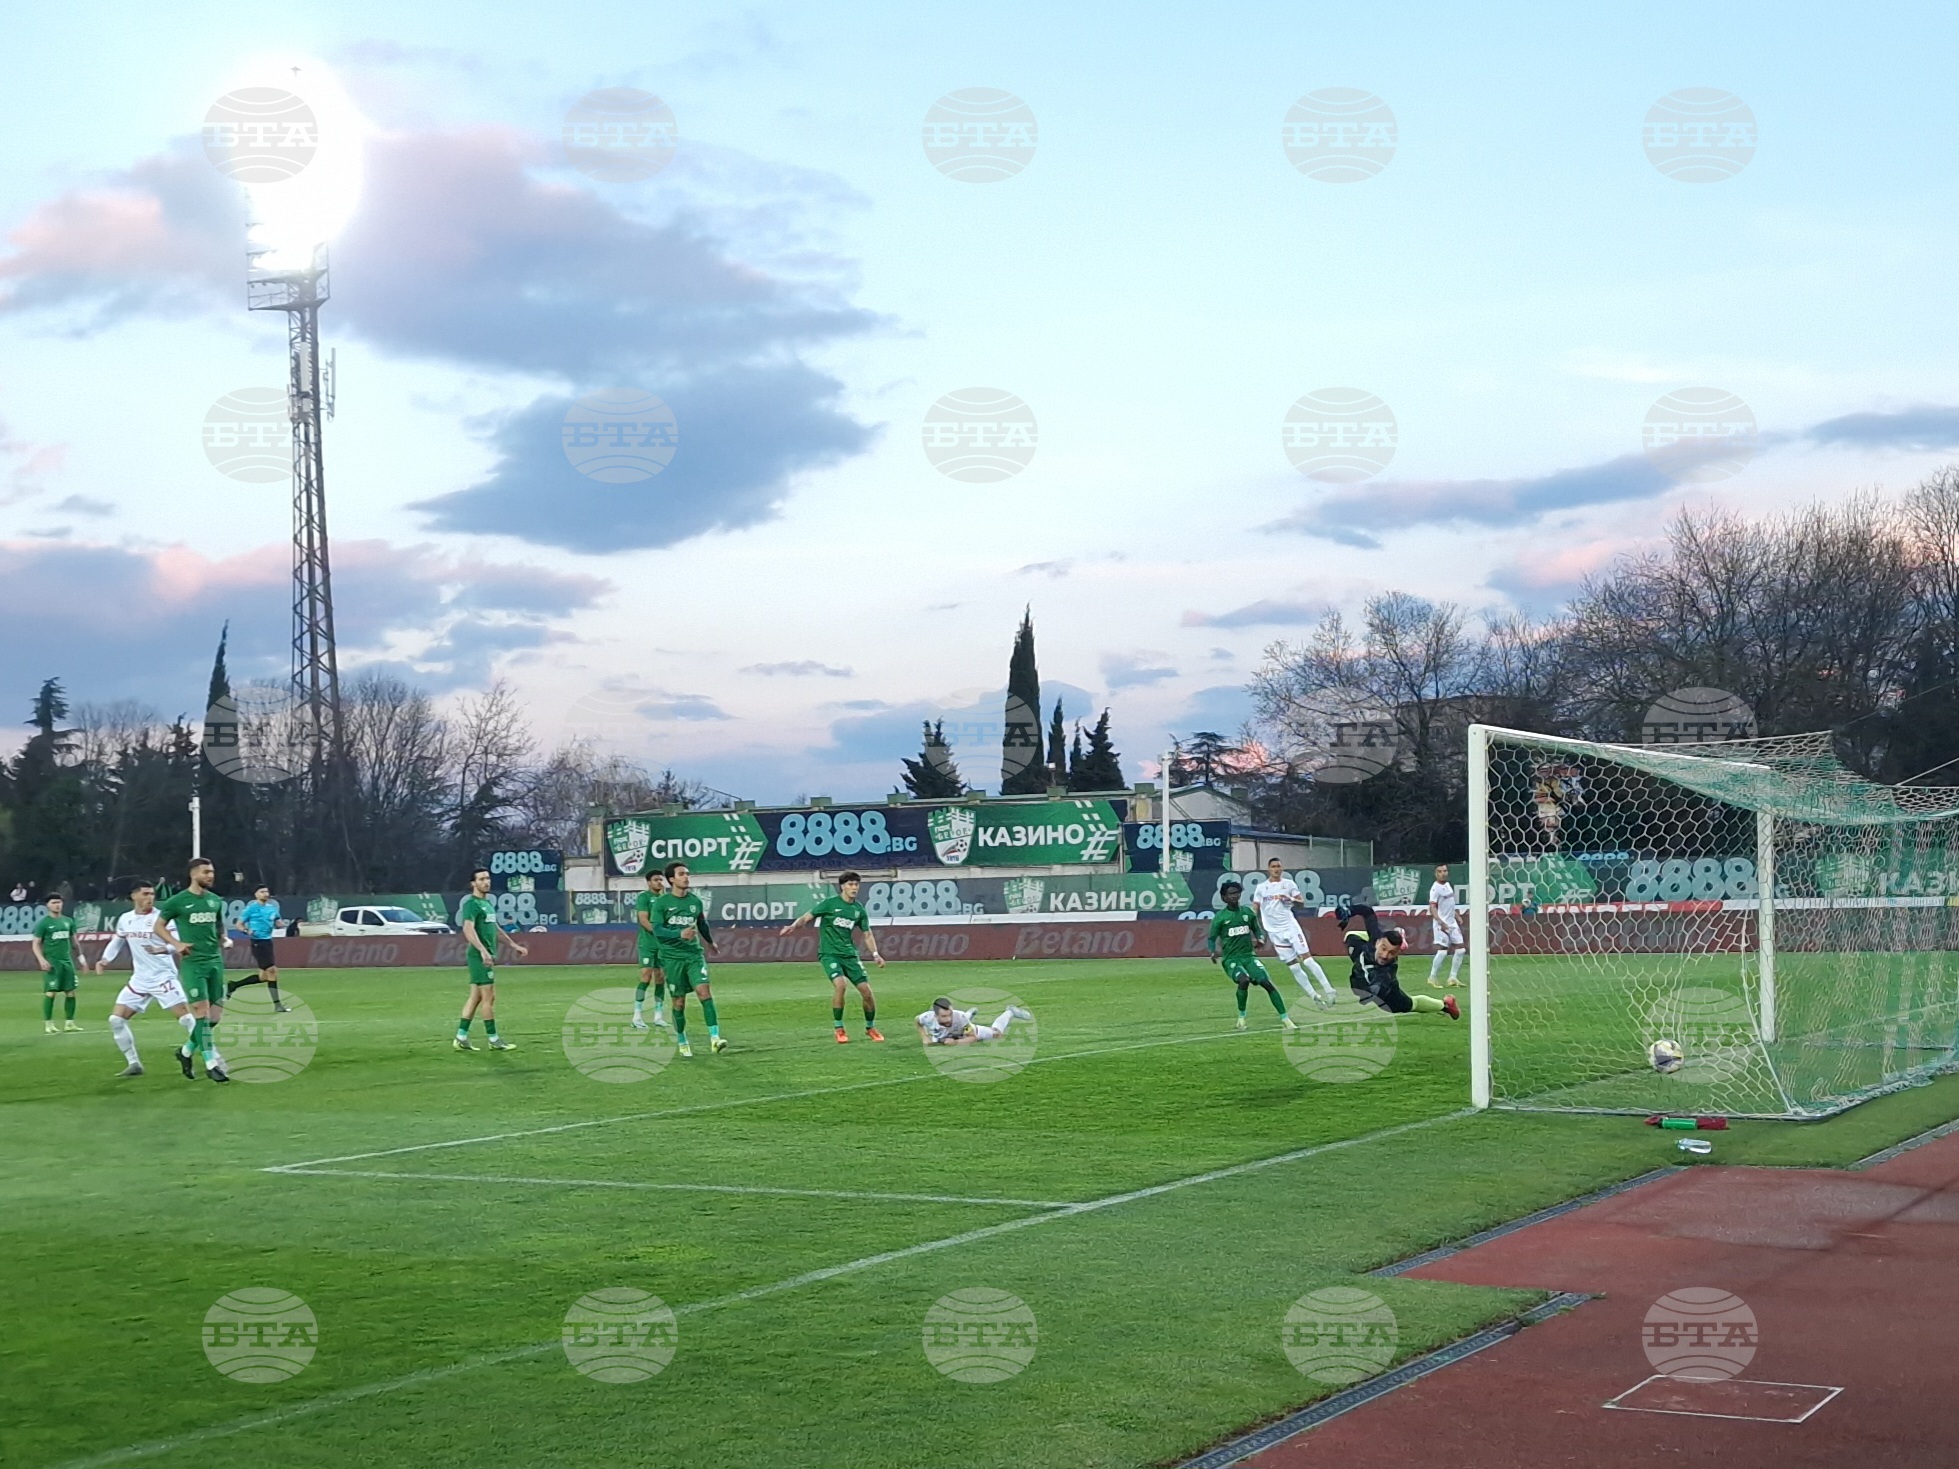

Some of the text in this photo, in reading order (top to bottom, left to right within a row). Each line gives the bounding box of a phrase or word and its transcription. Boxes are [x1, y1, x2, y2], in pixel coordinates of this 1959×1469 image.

[776, 810, 918, 857] 8888.BG
[978, 824, 1085, 847] КАЗИНО
[651, 837, 731, 859] СПОРТ
[490, 851, 557, 874] 8888.BG
[1625, 857, 1791, 902] 8888.G
[722, 901, 799, 921] СПОРТ
[865, 880, 984, 917] 8888.BG
[1049, 890, 1157, 912] КАЗИНО
[308, 940, 400, 964] Betano
[568, 934, 639, 963] Beta
[714, 931, 815, 960] Betano
[1015, 925, 1134, 956] Betano
